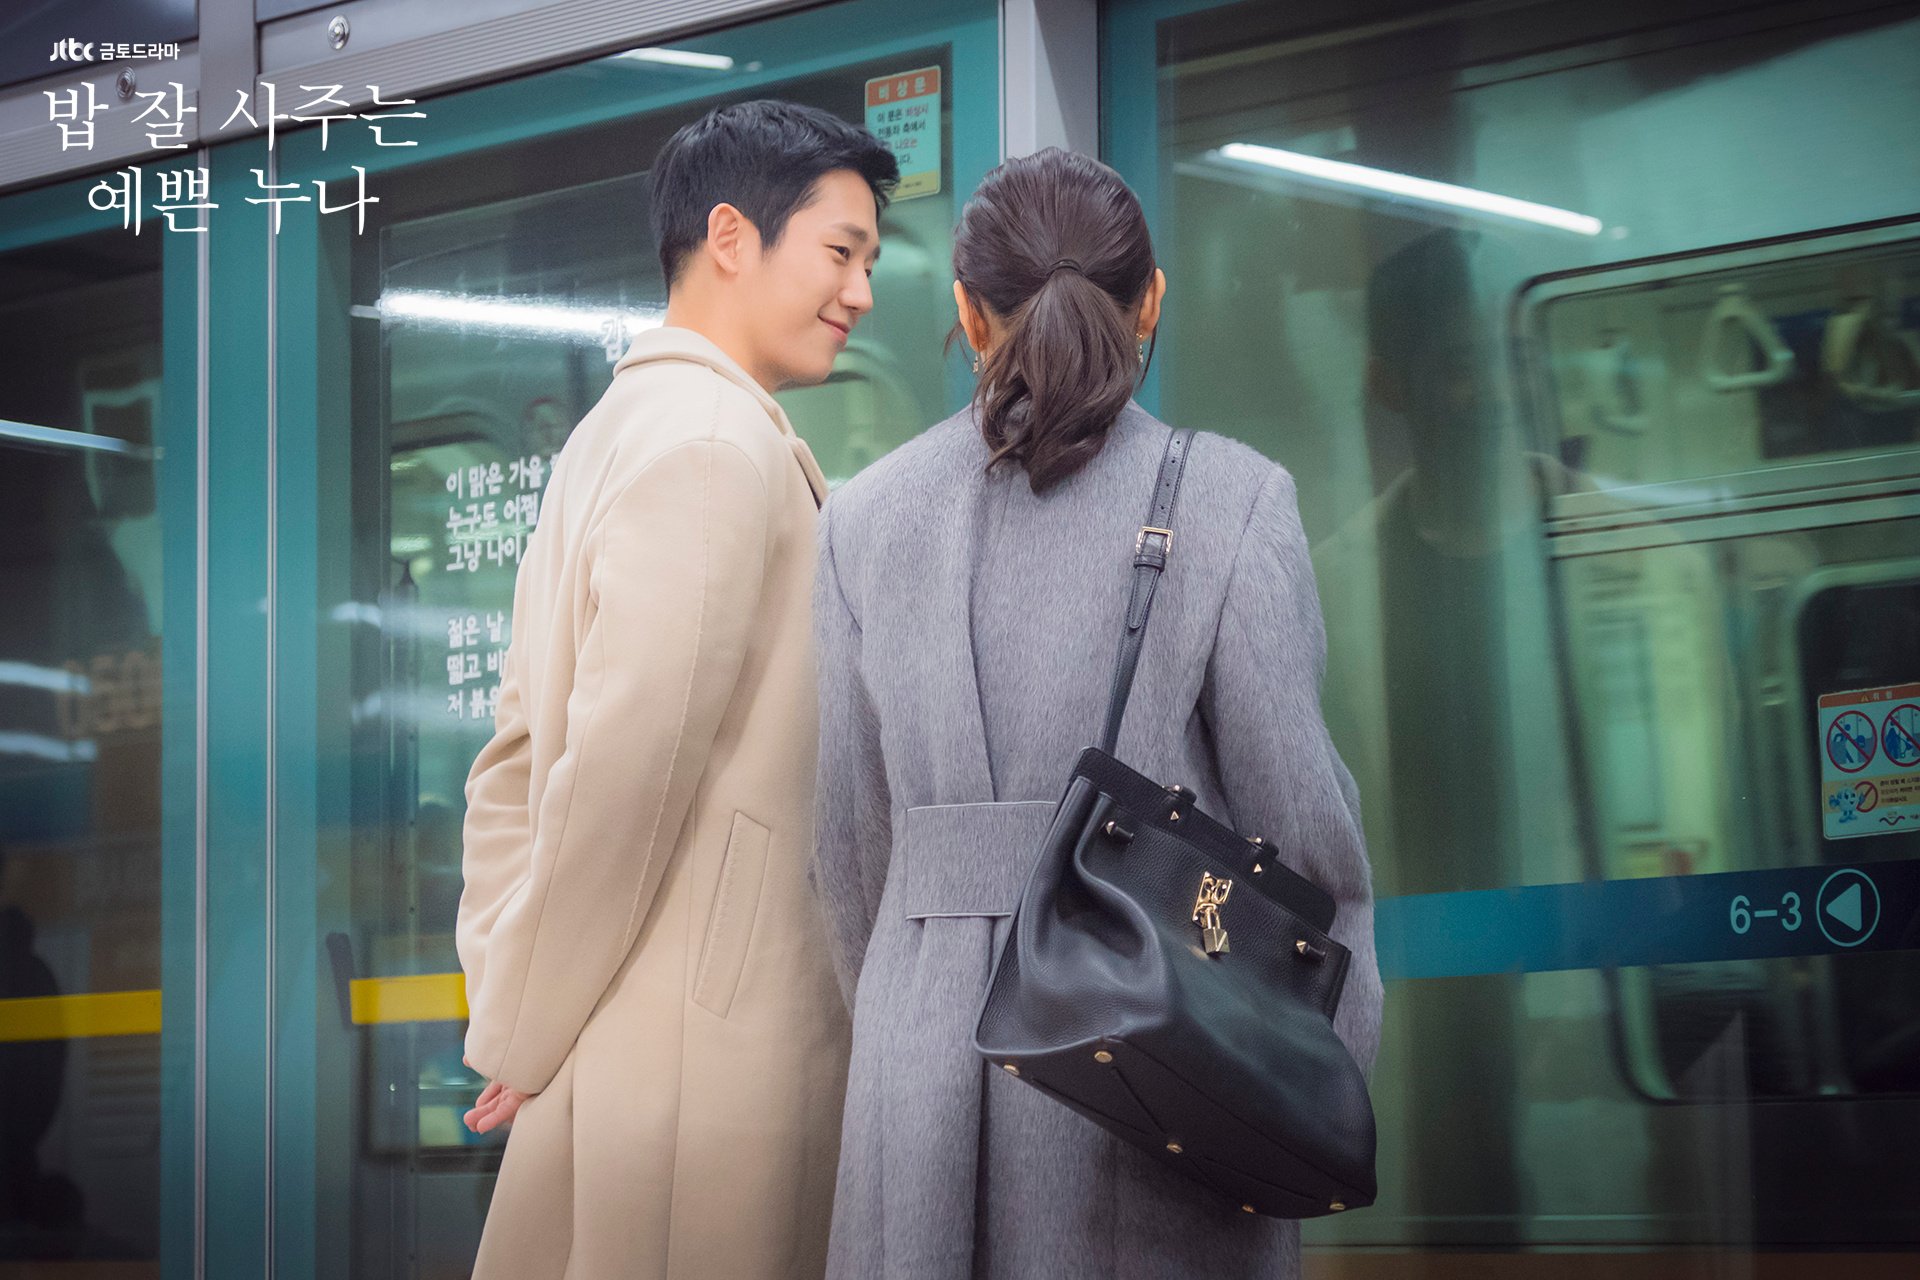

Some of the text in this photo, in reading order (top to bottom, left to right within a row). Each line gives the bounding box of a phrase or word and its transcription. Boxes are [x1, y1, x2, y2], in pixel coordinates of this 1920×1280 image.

[446, 467, 463, 499] 이
[508, 456, 544, 490] 가을
[446, 501, 499, 537] 누구도
[446, 538, 482, 572] 그냥
[487, 531, 522, 567] 나이
[447, 689, 463, 720] 저
[1730, 891, 1802, 934] 6-3
